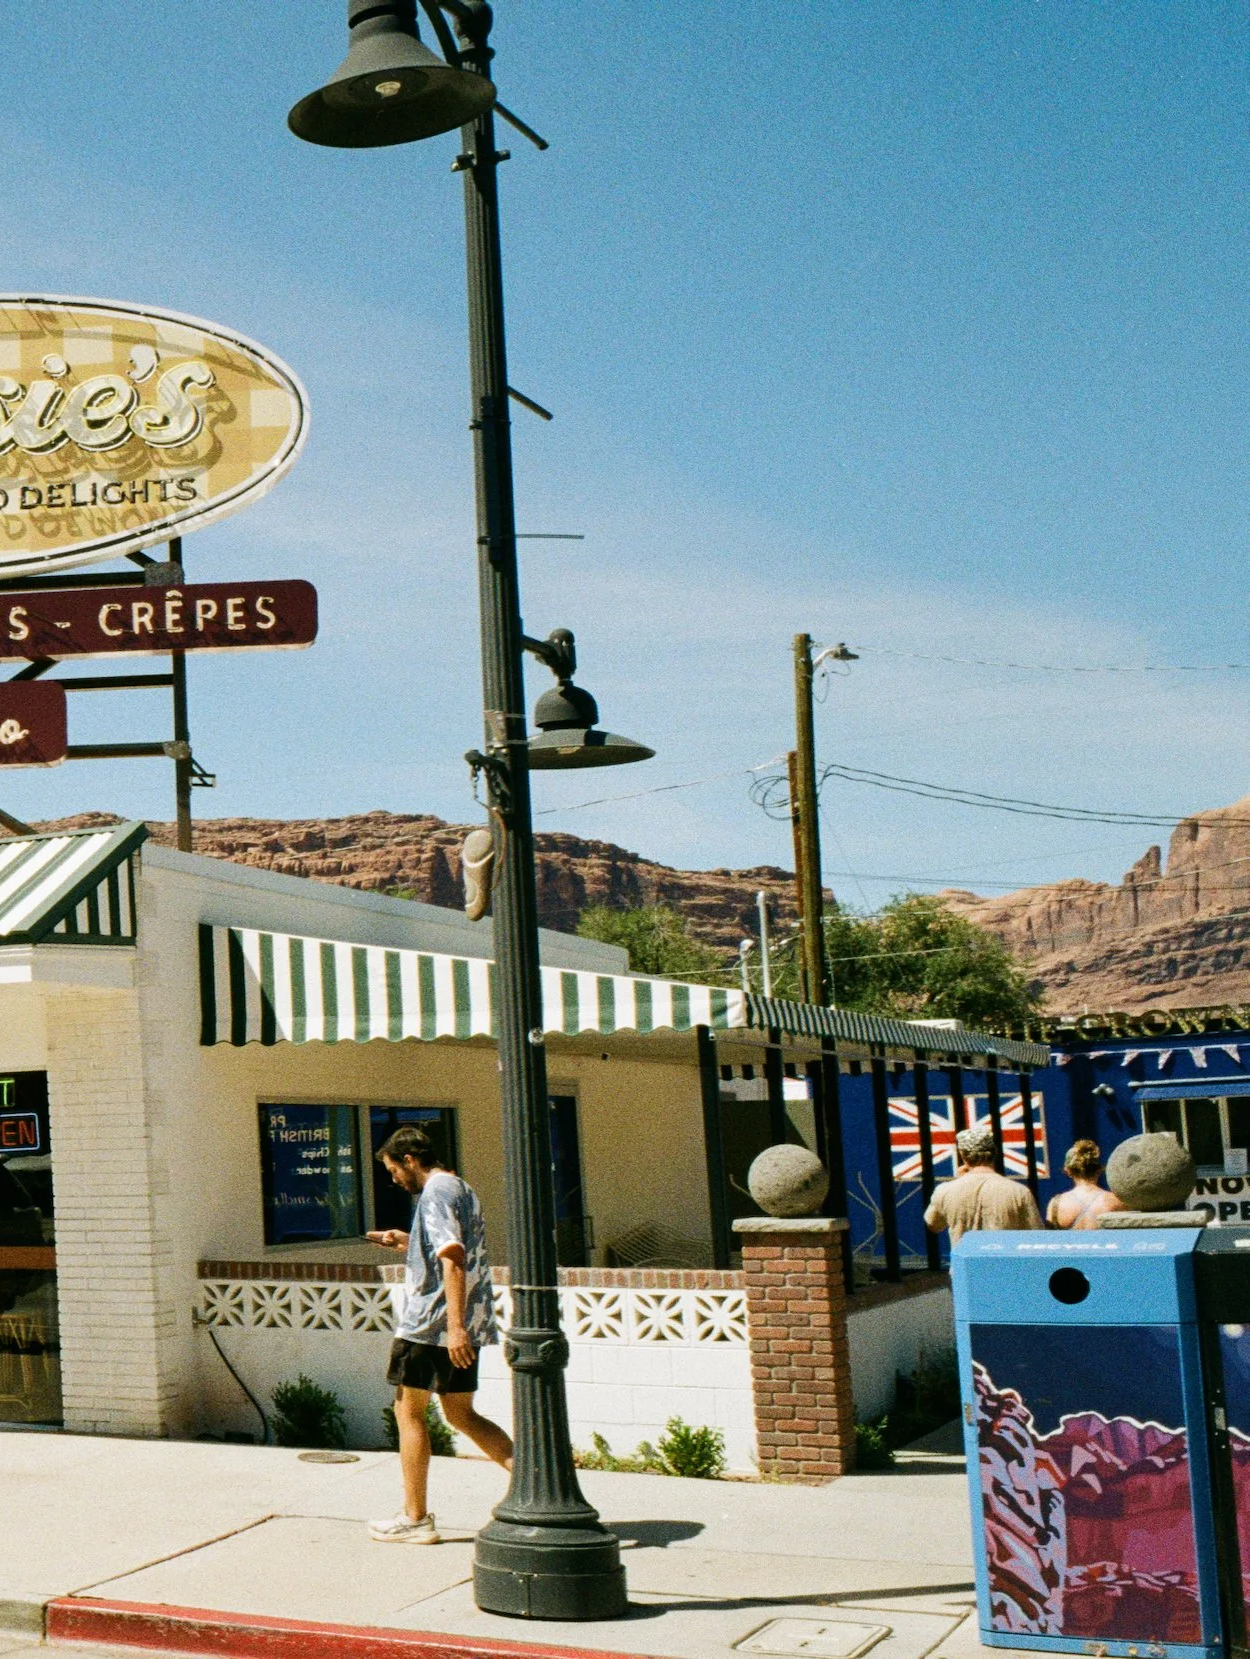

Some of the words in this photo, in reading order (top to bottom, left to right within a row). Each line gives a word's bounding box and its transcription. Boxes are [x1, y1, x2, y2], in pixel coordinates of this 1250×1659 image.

[19, 477, 198, 512] DELIGHTS
[98, 590, 276, 637] CRÊPES
[1195, 1177, 1250, 1196] NO
